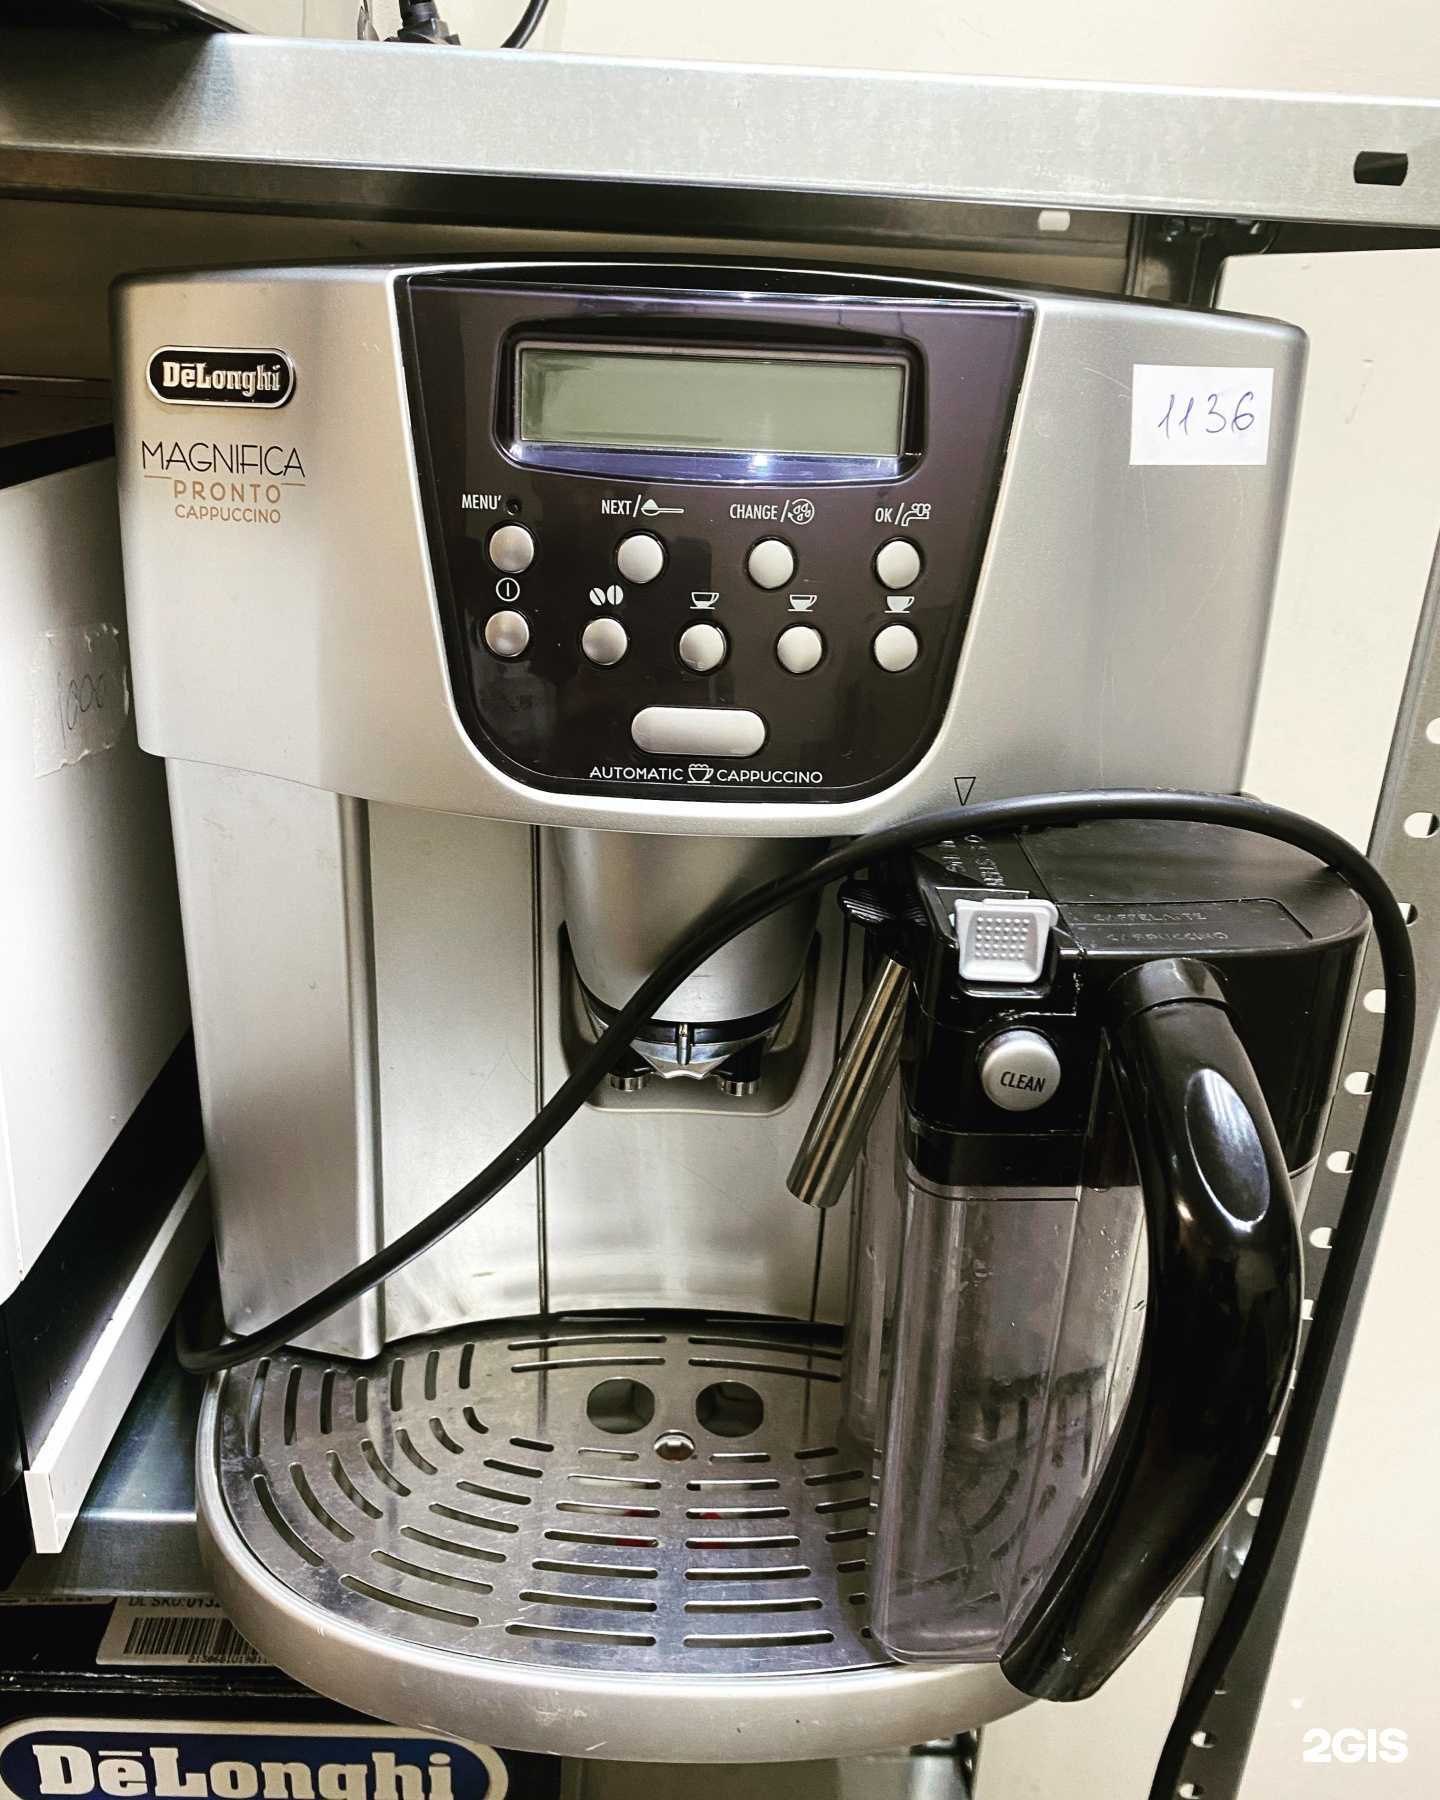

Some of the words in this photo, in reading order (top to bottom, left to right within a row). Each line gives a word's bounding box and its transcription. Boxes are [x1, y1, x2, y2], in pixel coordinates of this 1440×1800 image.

[1157, 390, 1256, 440] 1136
[141, 440, 306, 478] MAGNIFICA
[173, 479, 282, 504] PRONTO
[174, 504, 282, 524] CAPPUCCINO
[588, 766, 684, 781] AUTOMATIC
[716, 769, 823, 784] CAPPUCCINO
[999, 1071, 1046, 1093] CLEAN
